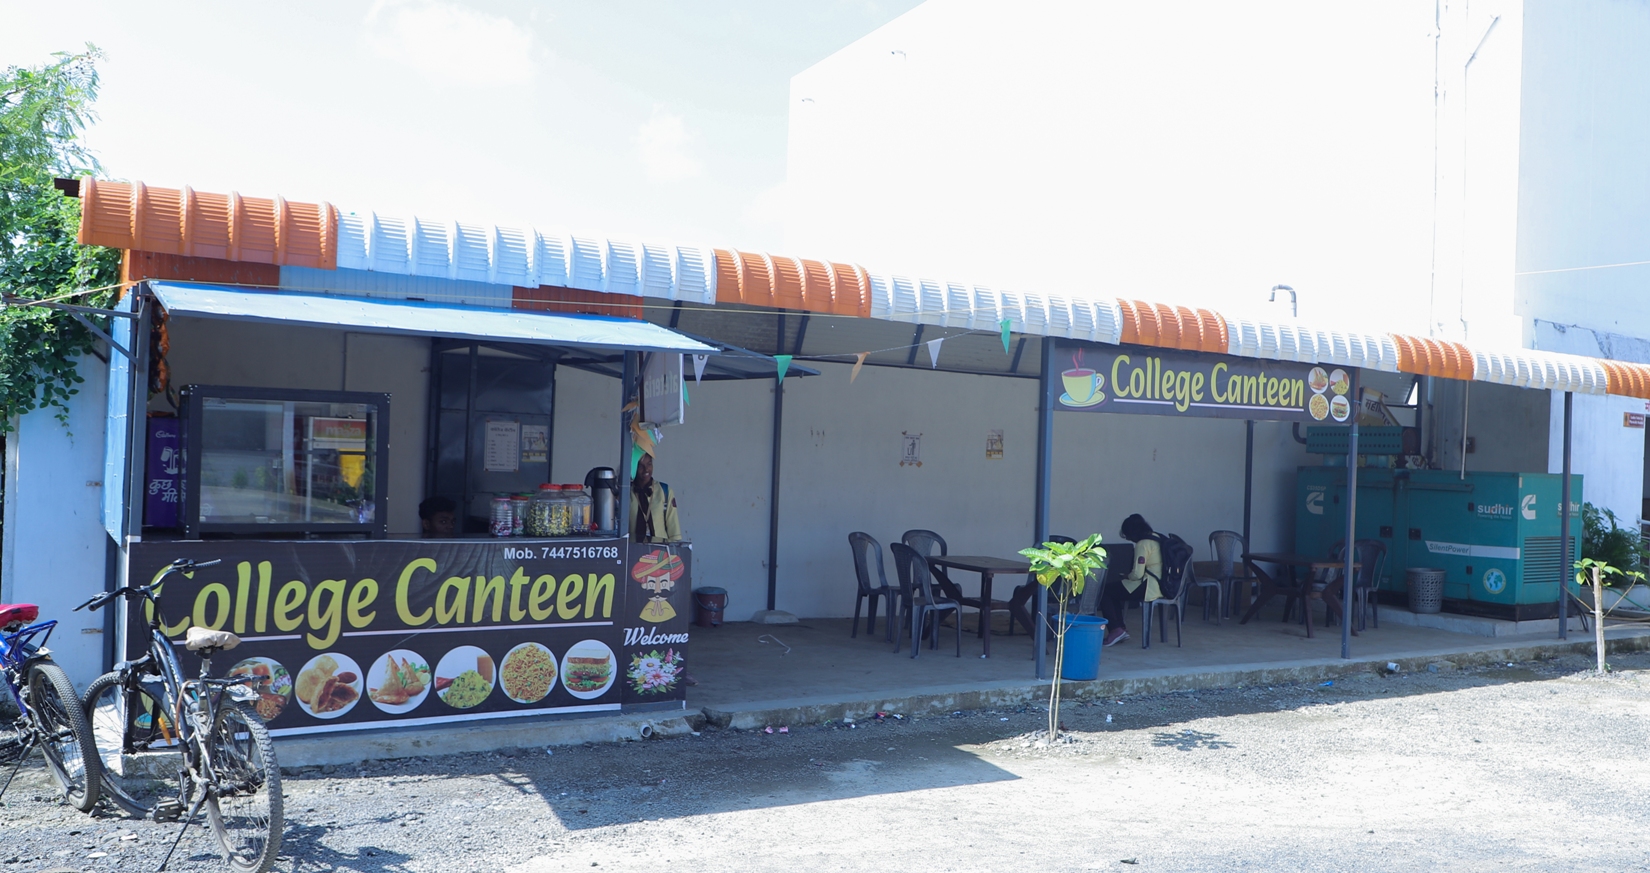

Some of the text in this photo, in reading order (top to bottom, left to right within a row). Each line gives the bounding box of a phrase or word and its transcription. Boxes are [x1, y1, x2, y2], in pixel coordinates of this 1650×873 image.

[1111, 354, 1304, 412] College Canteen
[148, 478, 173, 496] कुछ
[1477, 504, 1514, 516] sudhir
[1557, 501, 1580, 512] shir
[504, 547, 618, 560] Mob. 7447516768
[1428, 543, 1470, 554] SilentPower
[145, 557, 616, 650] College Canteen
[623, 627, 689, 646] Welcome
